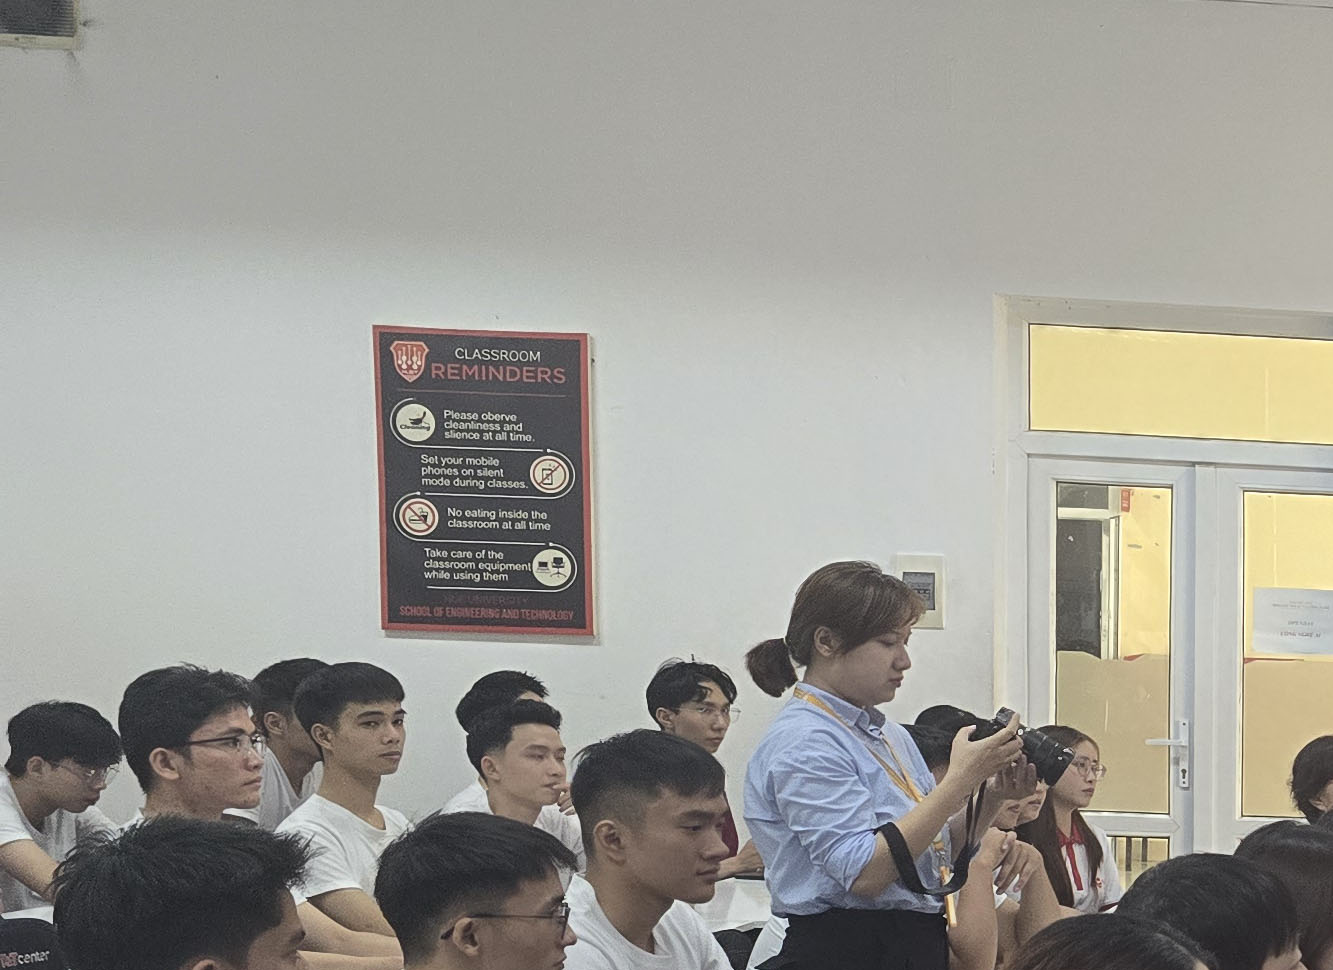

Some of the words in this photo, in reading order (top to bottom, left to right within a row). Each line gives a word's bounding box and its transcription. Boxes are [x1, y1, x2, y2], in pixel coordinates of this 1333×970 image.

[454, 347, 541, 363] CLASSROOM
[431, 362, 566, 384] REMINDERS
[443, 409, 479, 420] Please
[481, 412, 517, 421] oberve
[444, 420, 501, 431] cleanliness
[503, 422, 523, 432] and
[482, 432, 493, 440] at
[495, 432, 507, 441] all
[510, 432, 535, 442] time.
[420, 454, 439, 464] Set
[440, 457, 463, 466] your
[465, 456, 500, 466] mobile
[421, 466, 459, 476] phones
[461, 468, 474, 476] on
[476, 467, 504, 478] silent
[421, 477, 451, 486] mode
[453, 477, 485, 489] during
[487, 479, 529, 489] classes.
[447, 507, 462, 517] No
[464, 508, 496, 520] eating
[498, 509, 529, 519] inside
[531, 510, 548, 520] the
[447, 519, 500, 529] classroom
[501, 521, 512, 530] at
[514, 521, 526, 529] all
[528, 521, 551, 531] time
[424, 548, 448, 558] Take
[450, 550, 473, 559] care
[475, 549, 486, 559] of
[487, 550, 504, 560] the
[424, 559, 476, 569] classroom
[478, 562, 532, 572] equipment
[424, 570, 451, 580] while
[453, 571, 481, 582] using
[482, 572, 509, 581] them
[399, 605, 432, 617] SCHOOL
[433, 606, 445, 617] OF
[501, 608, 520, 619] AND
[520, 609, 574, 621] TECHNOLOGY
